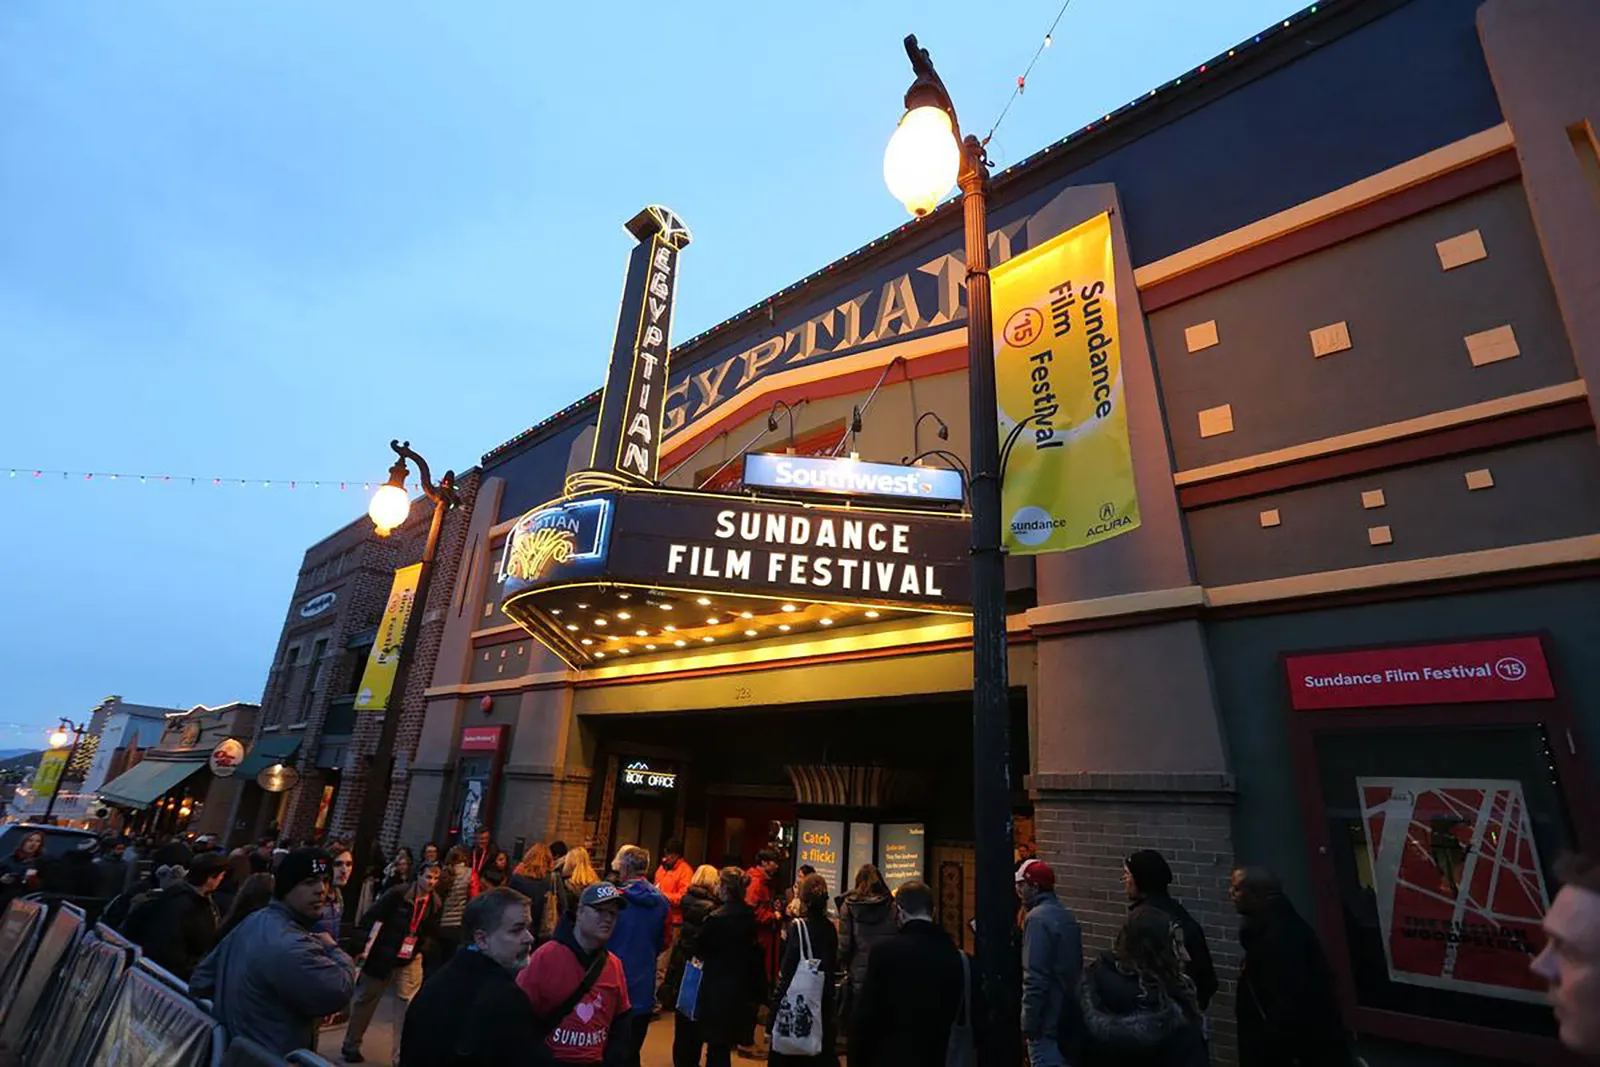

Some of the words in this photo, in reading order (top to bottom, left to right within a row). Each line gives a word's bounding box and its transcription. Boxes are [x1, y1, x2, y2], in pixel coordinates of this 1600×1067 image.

[661, 214, 1031, 437] GYPTIAN
[1049, 280, 1076, 338] Film
[623, 247, 671, 475] EGYPTIAN
[1079, 280, 1112, 419] Sundance
[1030, 349, 1064, 450] Festival
[775, 461, 919, 494] Southwest
[714, 509, 911, 553] SUNDANCE
[1010, 518, 1066, 531] sundance
[1085, 515, 1132, 537] ACURA
[666, 543, 752, 580] FILM
[767, 552, 943, 596] FESTIVAL
[1304, 672, 1382, 688] Sundance
[1385, 668, 1420, 683] Film
[1423, 662, 1491, 680] Festival
[625, 771, 644, 784] BOX
[648, 775, 675, 788] OFFICE
[801, 850, 808, 860] a
[810, 848, 836, 864] flick!
[802, 831, 831, 845] Catch
